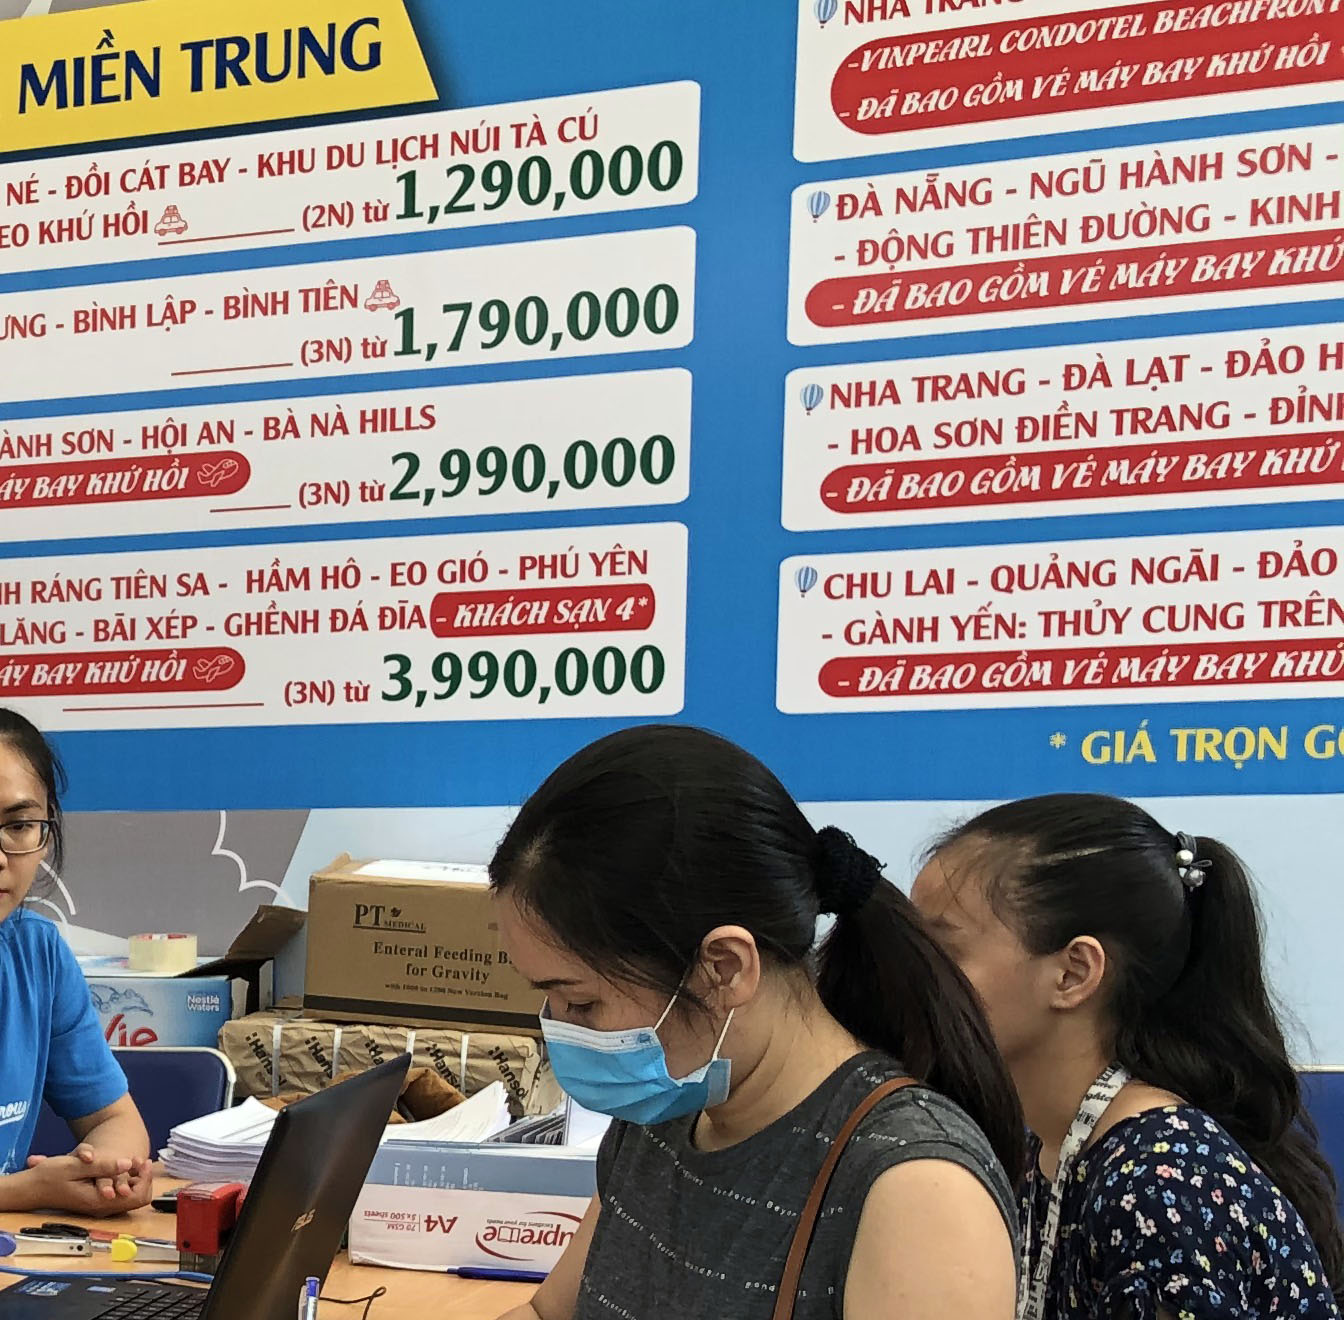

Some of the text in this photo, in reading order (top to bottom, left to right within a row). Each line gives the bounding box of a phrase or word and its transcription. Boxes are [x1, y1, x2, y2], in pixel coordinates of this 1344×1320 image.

[19, 30, 160, 114] MIỀN
[181, 18, 381, 92] TRUNG
[7, 173, 39, 206] NÉ
[65, 162, 110, 199] ĐỒI
[120, 160, 170, 193] CÁT
[179, 158, 230, 187] BAY
[258, 148, 315, 178] KHU
[327, 142, 364, 170] DU
[376, 134, 438, 174] LỊCH
[447, 120, 508, 170] NÚI
[510, 114, 547, 162] TÀ
[558, 107, 600, 157] CÚ
[303, 140, 688, 232] (2N) từ 1,290,000
[62, 428, 113, 455] SƠN
[142, 417, 187, 454] HỘI
[197, 420, 234, 451] AN
[264, 408, 300, 440] BÀ
[311, 404, 349, 437] NÀ
[360, 405, 436, 434] HILLS
[299, 435, 675, 509] (3N) từ 2,990,000
[824, 540, 1337, 600] CHU LAI QUẢNG NGÃI ĐẢO
[1082, 720, 1287, 768] GIÁ TRỌN
[355, 903, 386, 927] PT
[374, 942, 492, 965] Enteral Feeding
[407, 963, 489, 984] for Gravity
[187, 995, 220, 1004] Nestlé
[249, 1038, 287, 1087] Hansl
[424, 1214, 458, 1234] A4
